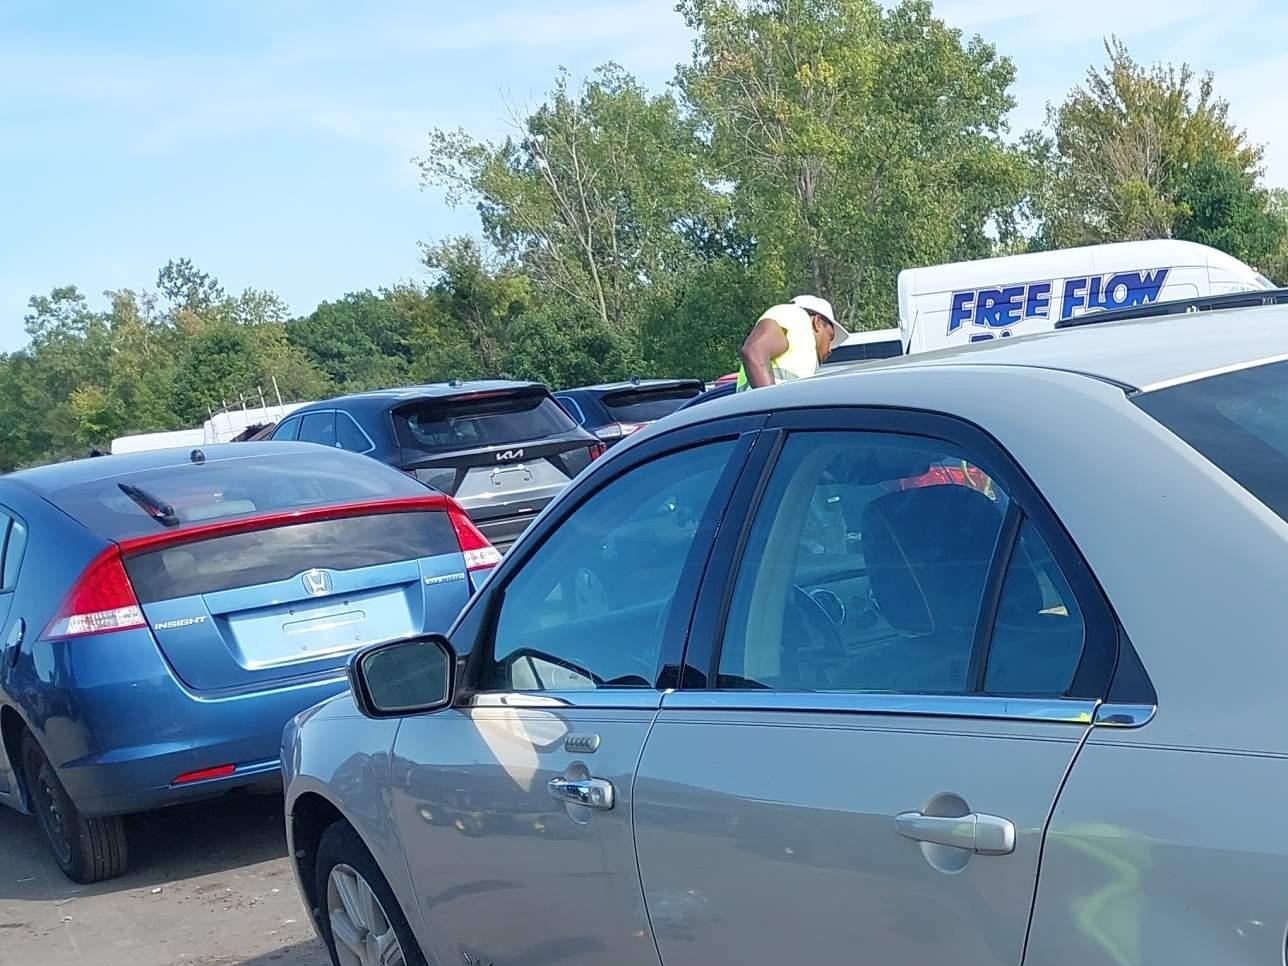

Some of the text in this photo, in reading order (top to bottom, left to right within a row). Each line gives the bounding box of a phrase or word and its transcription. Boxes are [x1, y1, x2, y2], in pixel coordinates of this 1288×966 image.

[947, 267, 1172, 335] FREE FLOW
[154, 615, 208, 630] INSIGHT
